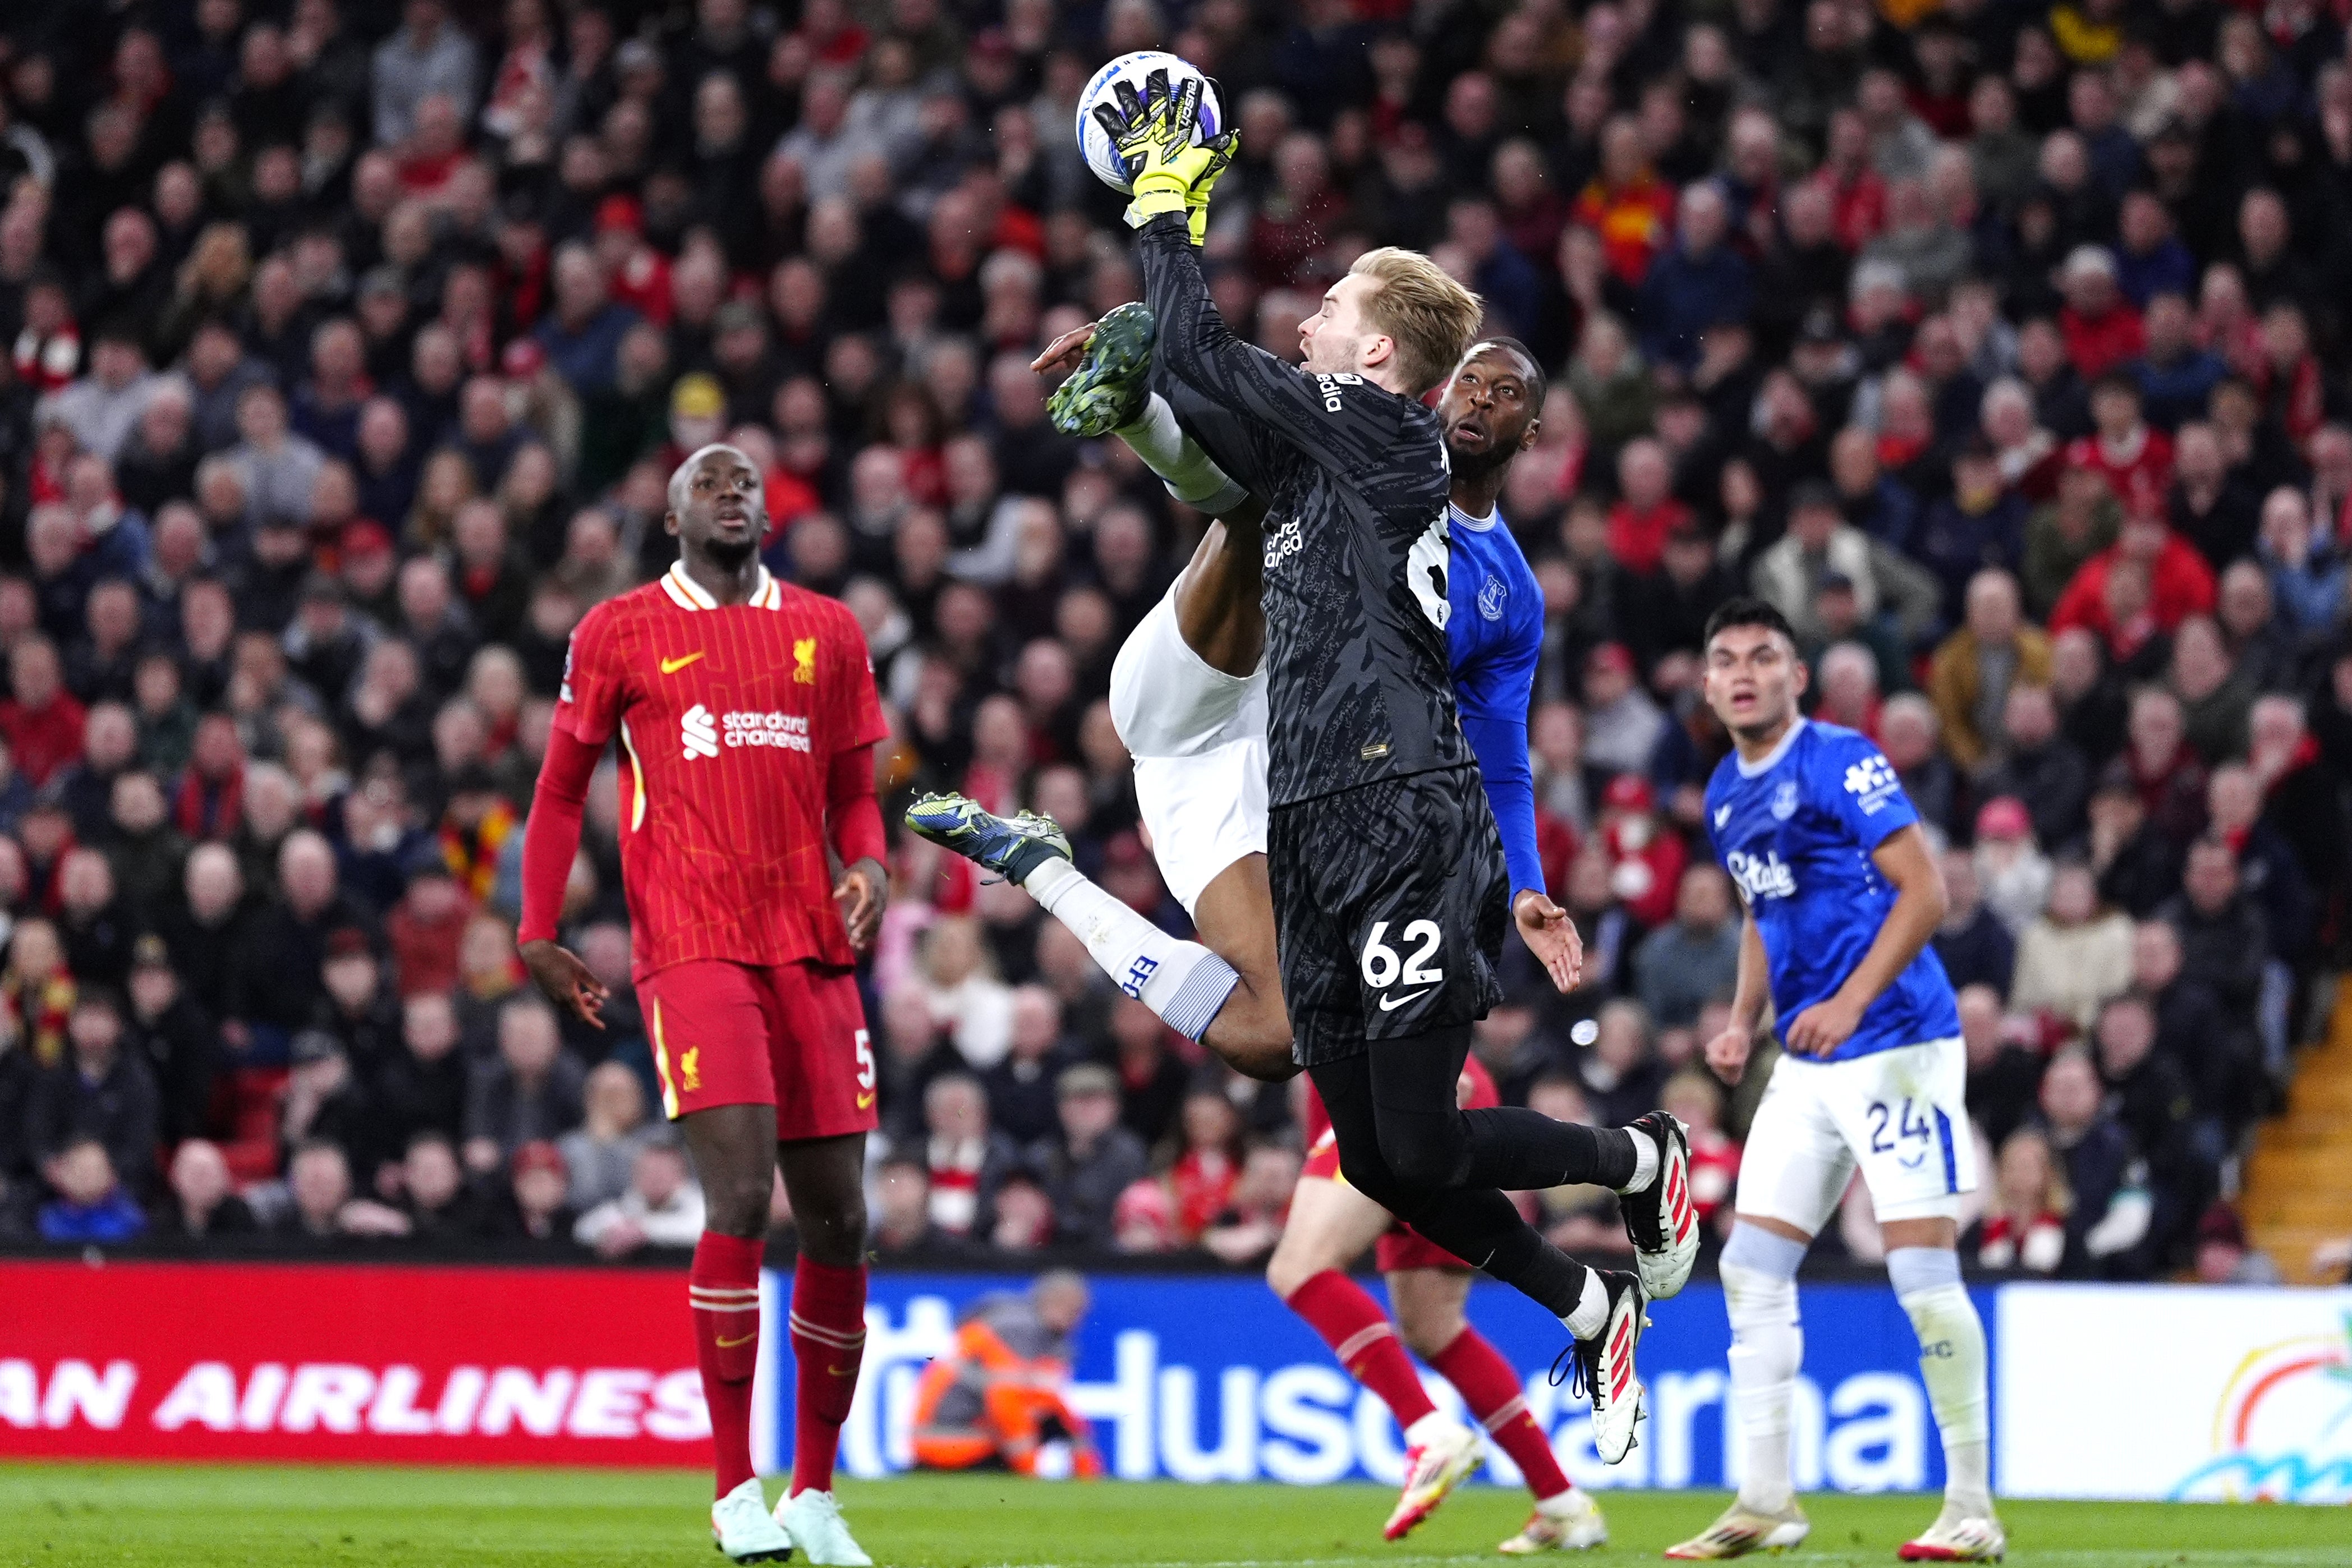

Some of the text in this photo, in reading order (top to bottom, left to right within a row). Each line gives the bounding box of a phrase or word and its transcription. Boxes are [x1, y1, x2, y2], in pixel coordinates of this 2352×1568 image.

[1180, 77, 1198, 127] reusch
[722, 711, 808, 735] standard
[724, 729, 812, 754] charteed
[1361, 919, 1443, 988] 62
[855, 1029, 876, 1089] 5
[1867, 1096, 1930, 1153] 24
[152, 1361, 713, 1441] AIRLINES
